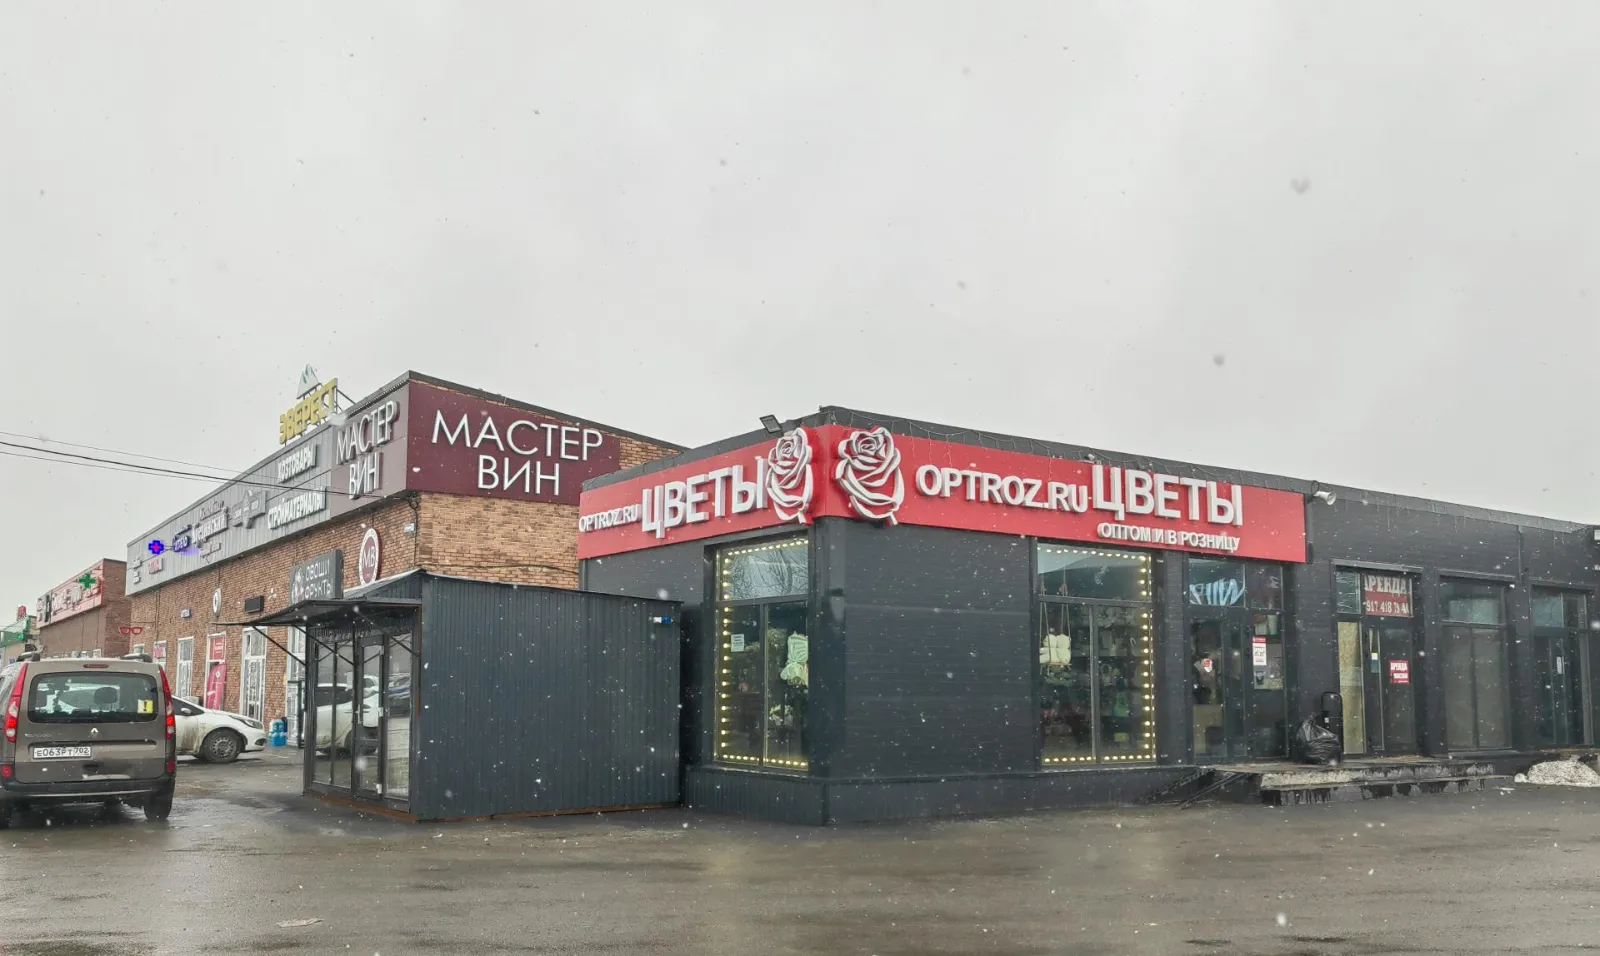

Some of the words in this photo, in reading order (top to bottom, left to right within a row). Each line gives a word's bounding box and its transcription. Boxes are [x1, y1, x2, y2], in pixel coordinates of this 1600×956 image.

[280, 377, 338, 445] ЭВЕРЕСТ
[336, 400, 398, 465] МАСТЕР
[431, 409, 603, 461] МАСТЕР
[348, 451, 382, 500] ВИН
[477, 454, 561, 496] ВИН
[578, 503, 642, 533] OPTROZ.RU
[641, 455, 769, 539] ЦВЕТЫ
[916, 464, 1089, 513] OPTROZ.RU
[1092, 464, 1243, 527] ЦВЕТЫ
[1097, 522, 1151, 542] ОПТОМ
[1153, 528, 1164, 543] И
[1165, 529, 1177, 545] В
[1179, 531, 1240, 553] РОЗНИЦУ
